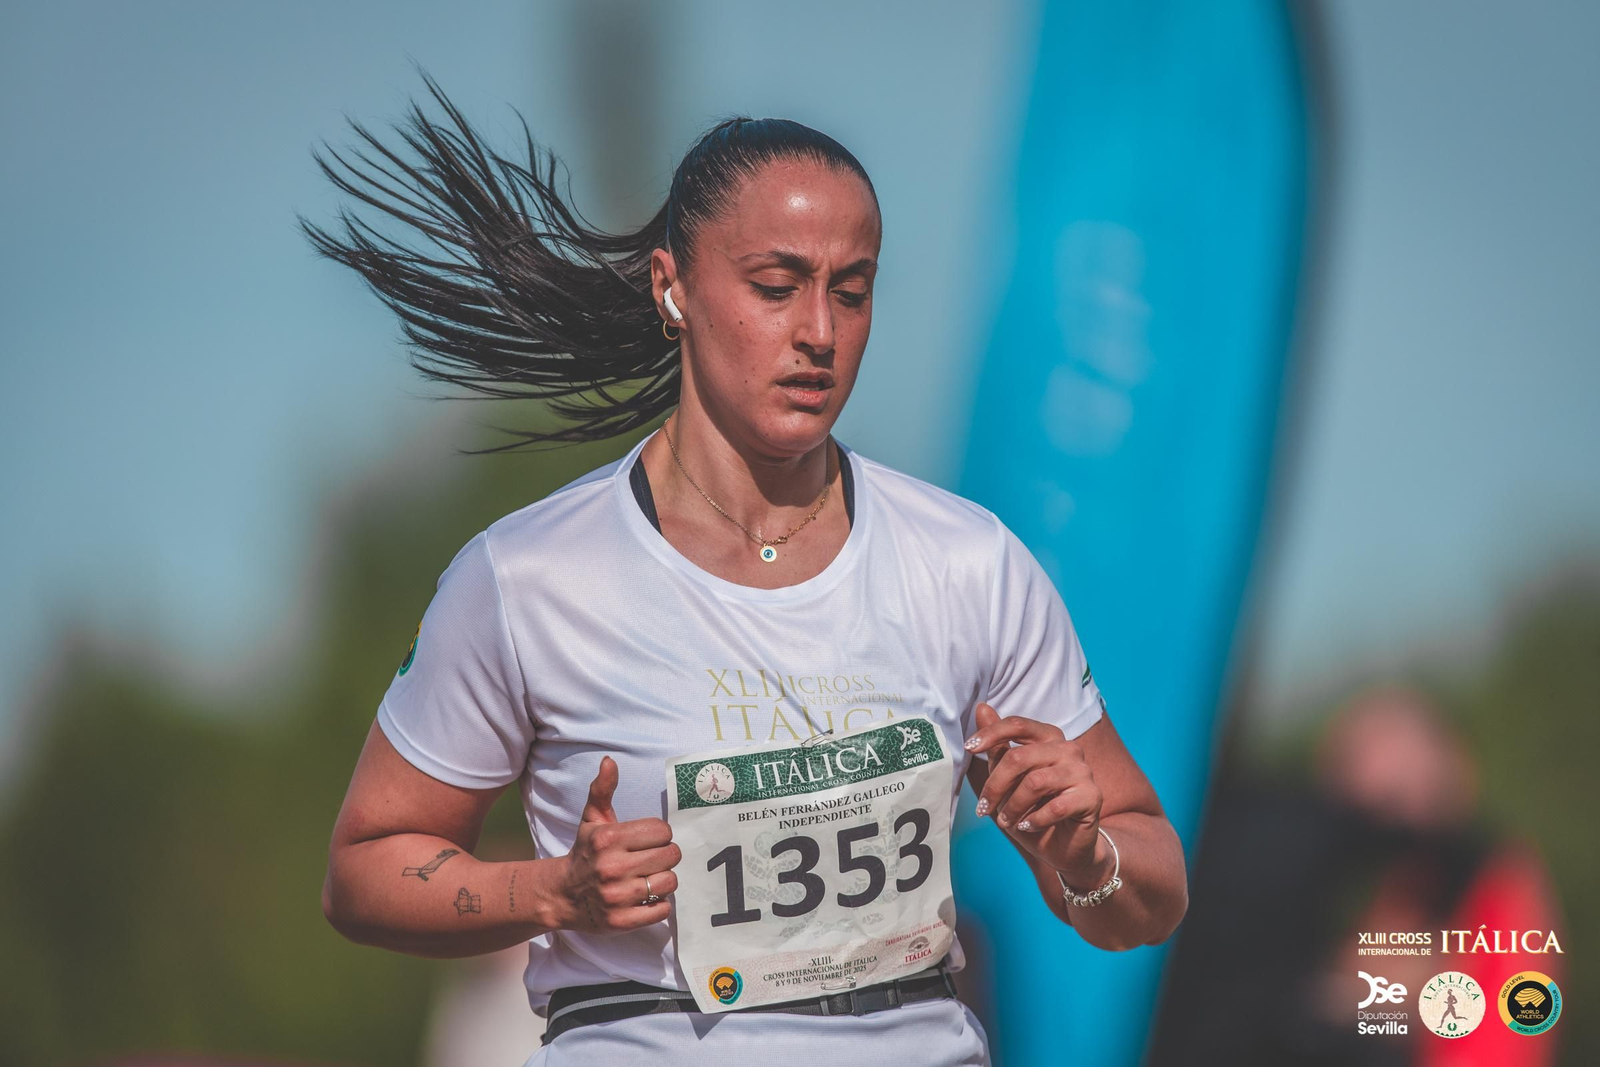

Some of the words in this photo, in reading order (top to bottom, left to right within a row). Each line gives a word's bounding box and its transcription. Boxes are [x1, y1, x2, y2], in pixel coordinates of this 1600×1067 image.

[798, 675, 876, 695] CROSS
[802, 693, 903, 706] INTERNACIONAL
[709, 697, 895, 741] ITÁLIC
[753, 743, 884, 789] ITÁLICA
[903, 753, 929, 766] Sevilla
[758, 783, 819, 797] INTERNATIONAL
[823, 777, 848, 788] CROSS
[850, 767, 885, 781] COUNTRY
[738, 801, 777, 822] BELÉN
[781, 796, 851, 817] FERRÁNDEZ
[853, 781, 905, 803] GALLEGO
[778, 804, 872, 829] INDEPENDIENTE
[707, 808, 933, 927] 1353
[763, 972, 785, 981] CROSS
[787, 963, 843, 977] INTERNACIONAL
[844, 961, 852, 969] DE
[792, 977, 802, 985] DE
[803, 970, 842, 983] NOVIEMBRE
[853, 965, 866, 974] 2025
